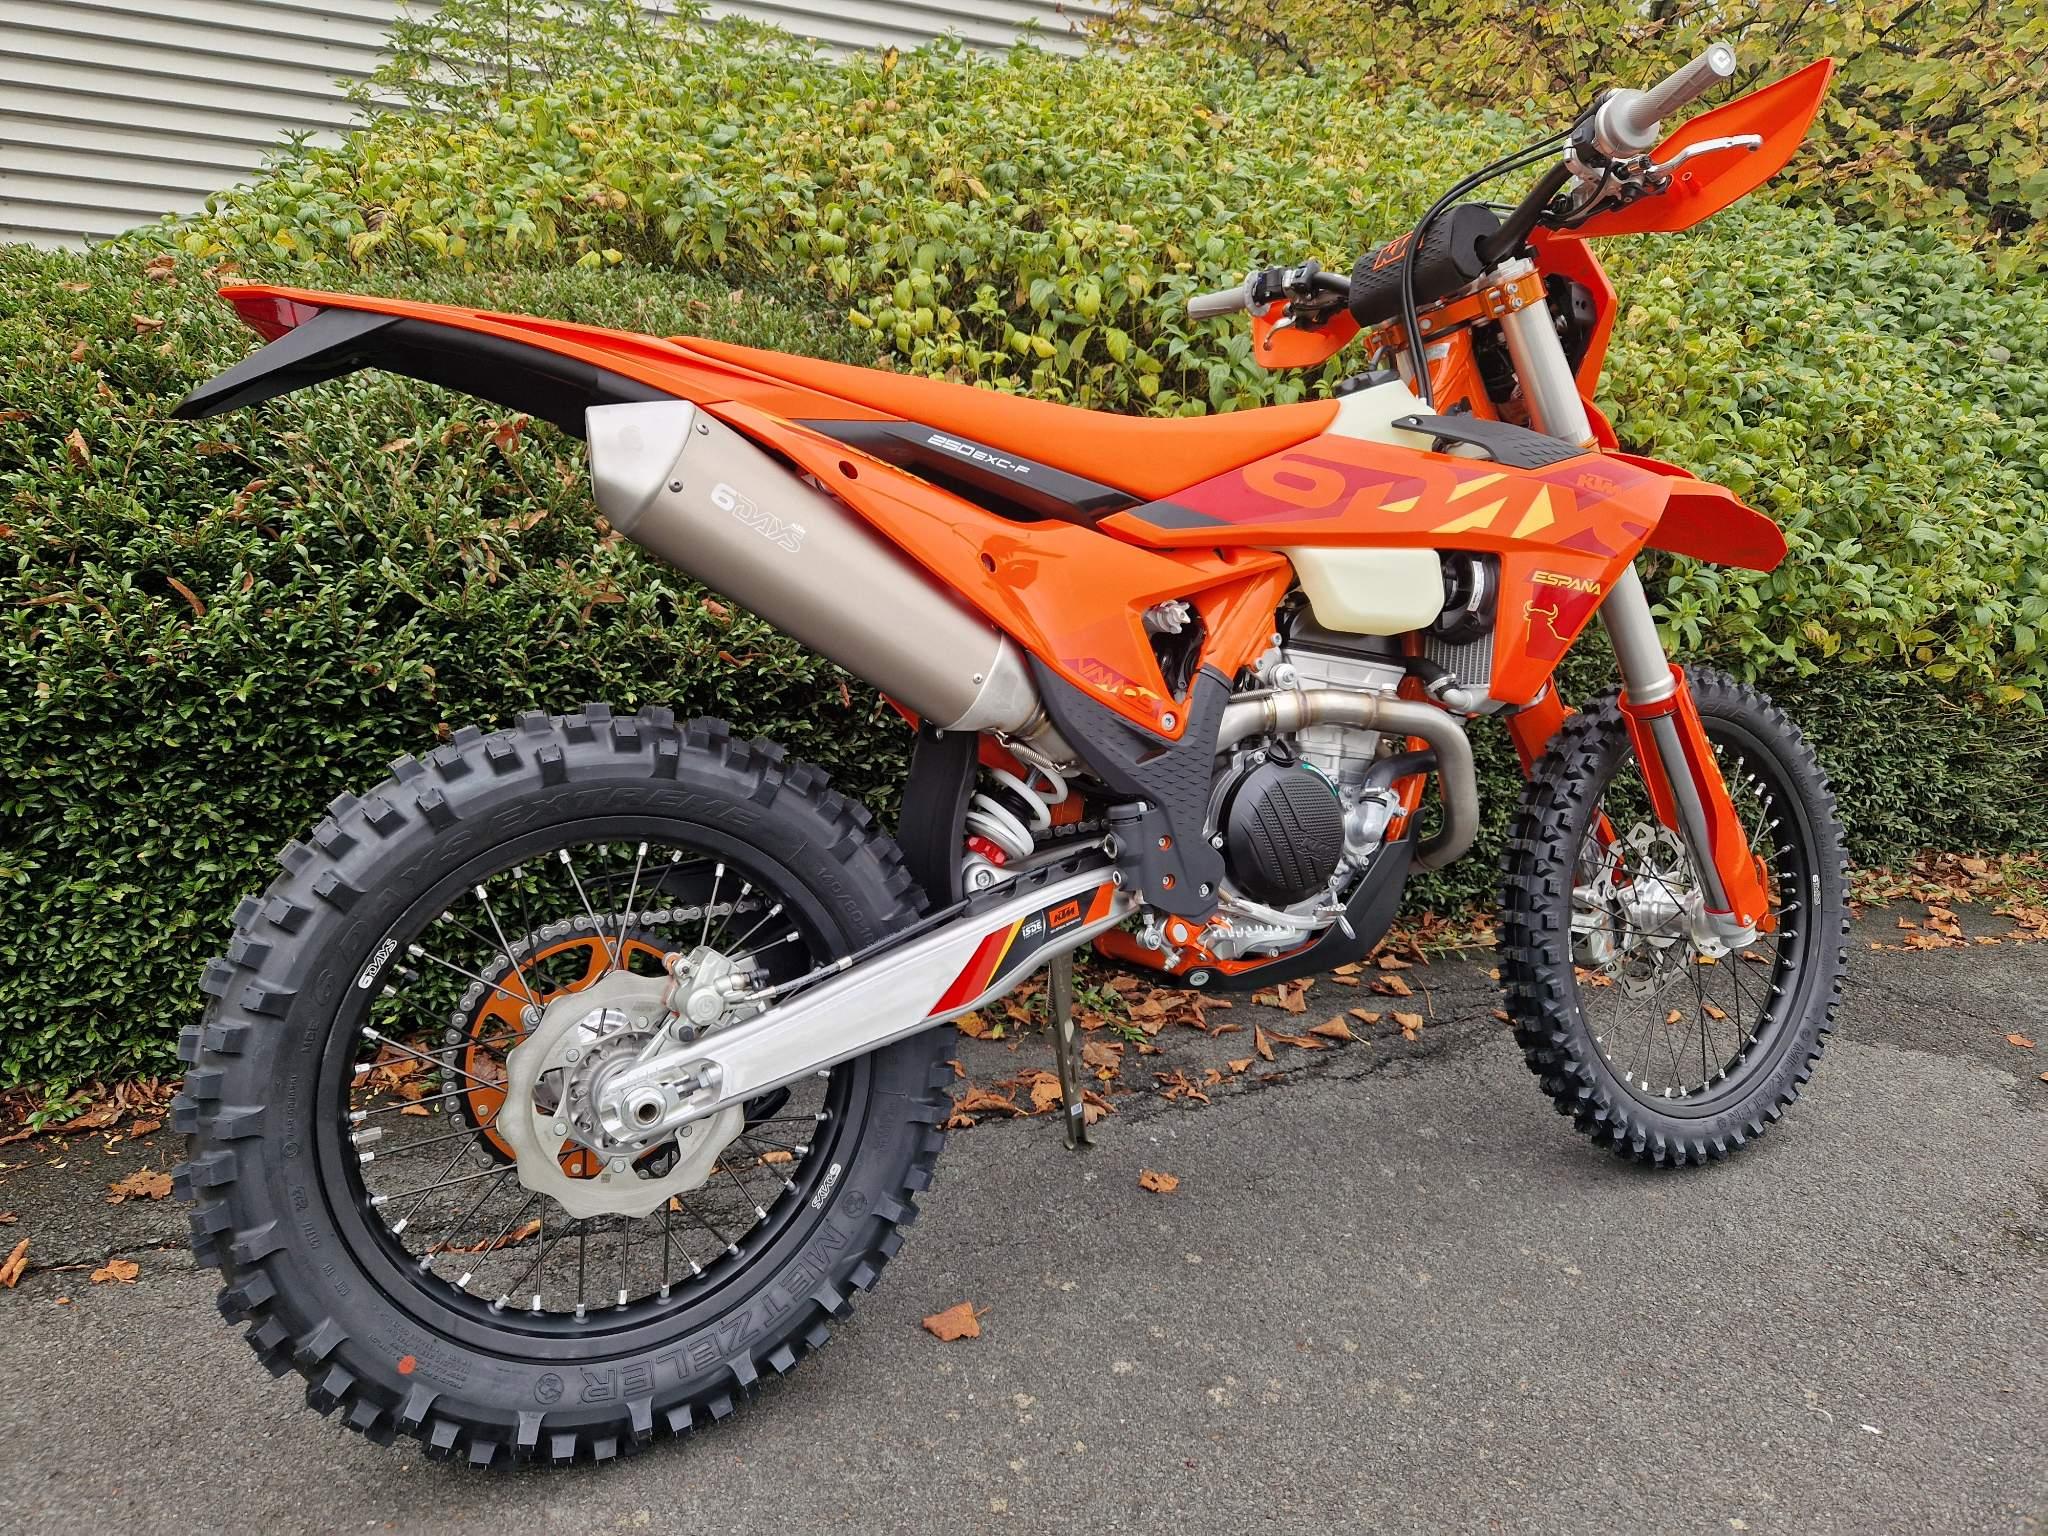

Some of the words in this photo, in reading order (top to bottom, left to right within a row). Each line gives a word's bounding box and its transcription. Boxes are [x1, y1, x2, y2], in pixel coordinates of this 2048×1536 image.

[1373, 230, 1425, 272] KT
[1577, 473, 1620, 497] KTM
[711, 482, 805, 553] 6DAYS
[1531, 571, 1602, 595] ESPAÑA
[1077, 658, 1157, 715] VAMOS
[492, 786, 761, 829] EXTREME
[1053, 906, 1076, 923] KTM
[358, 938, 398, 989] 6DAYS
[811, 1163, 842, 1210] 6DAYS
[580, 1222, 849, 1403] METZELER
